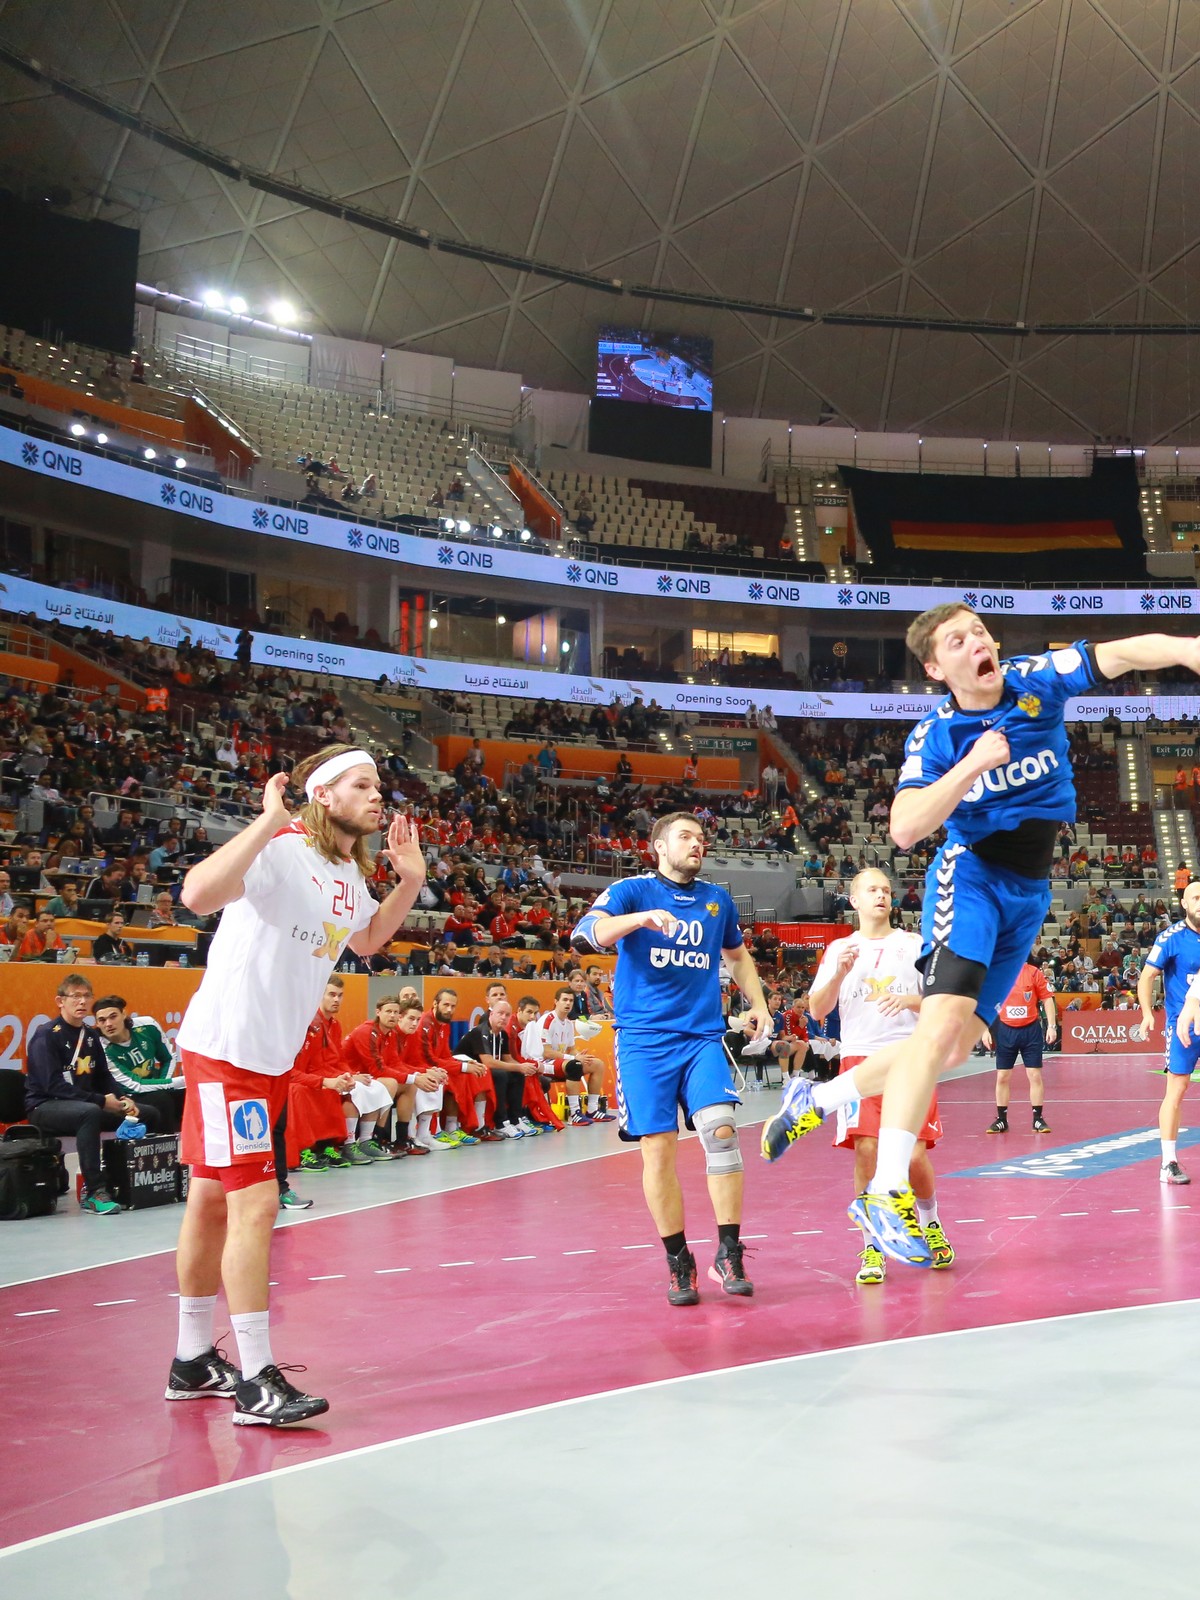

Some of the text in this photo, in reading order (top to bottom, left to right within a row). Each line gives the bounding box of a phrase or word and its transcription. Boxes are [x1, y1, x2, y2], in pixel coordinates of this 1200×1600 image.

[43, 450, 83, 476] QNB
[179, 491, 213, 514] QNB
[272, 514, 309, 535] QNB
[366, 534, 400, 554] QNB
[457, 550, 493, 569] QNB
[585, 568, 618, 586] QNB
[676, 578, 710, 594] QNB
[766, 586, 800, 601] QNB
[856, 591, 890, 605] QNB
[981, 595, 1014, 609] QNB
[1069, 596, 1103, 610] QNB
[1158, 595, 1192, 609] QNB
[265, 645, 345, 666] Opening Soon
[676, 693, 753, 706] Opening Soon
[1077, 705, 1151, 716] Opening Soon
[1156, 745, 1194, 758] Exit 120
[331, 879, 355, 920] 24
[676, 919, 703, 947] 20
[873, 948, 884, 969] 7
[1071, 1025, 1127, 1041] QATAR
[127, 1047, 144, 1066] 16
[133, 1145, 155, 1158] SPORTS
[235, 1141, 271, 1154] Gjensidige
[141, 1168, 175, 1186] Mueller
